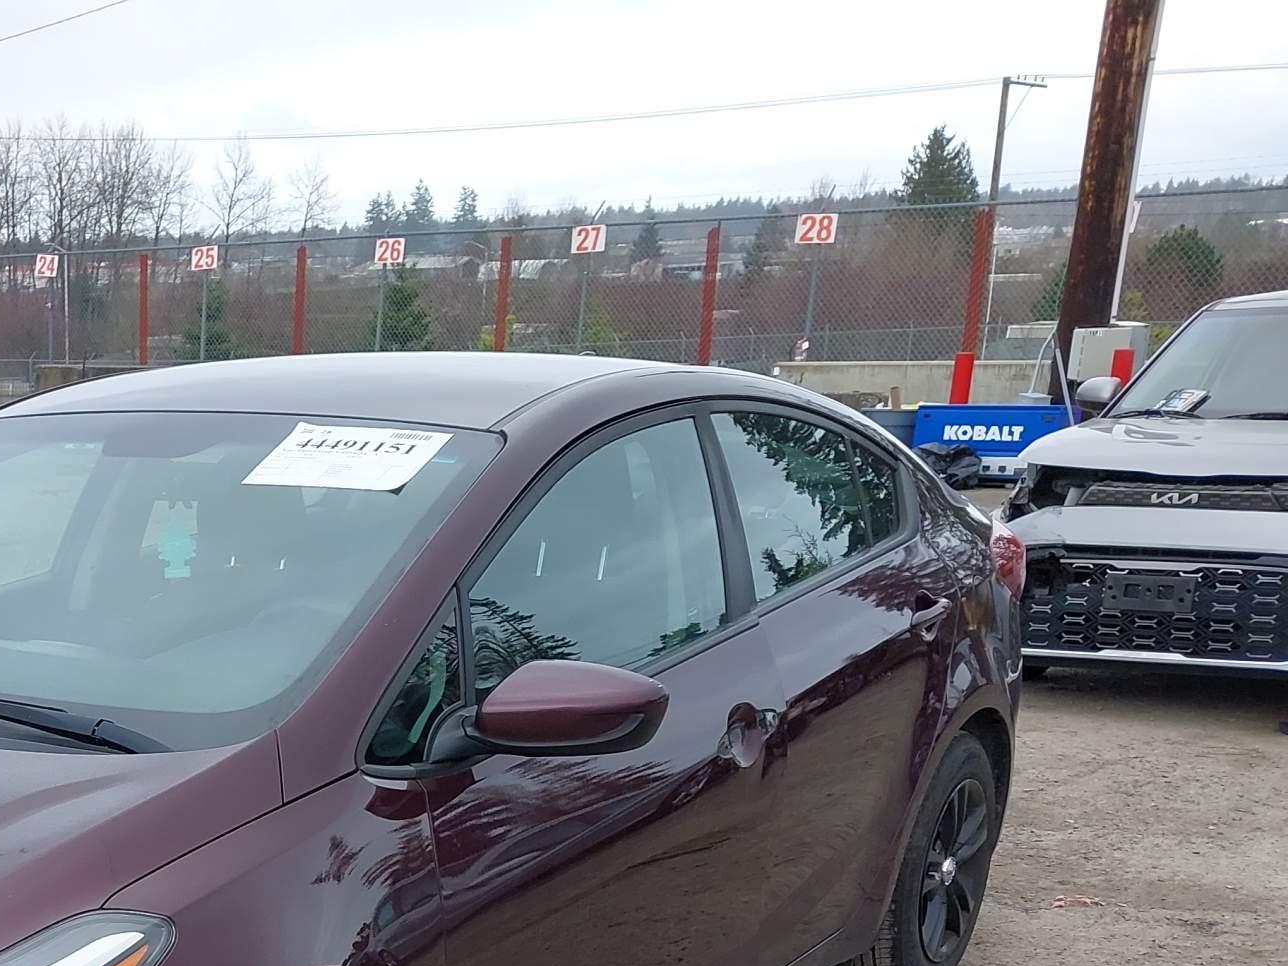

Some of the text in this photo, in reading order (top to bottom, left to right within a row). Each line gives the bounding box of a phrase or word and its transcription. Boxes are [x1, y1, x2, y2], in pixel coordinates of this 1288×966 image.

[576, 226, 602, 251] 27
[799, 215, 833, 242] 28
[194, 247, 216, 269] 25
[377, 240, 401, 262] 26
[37, 256, 56, 275] 24
[943, 425, 1024, 441] KOBALT
[296, 438, 417, 455] 44491151
[1150, 492, 1199, 504] KIA
